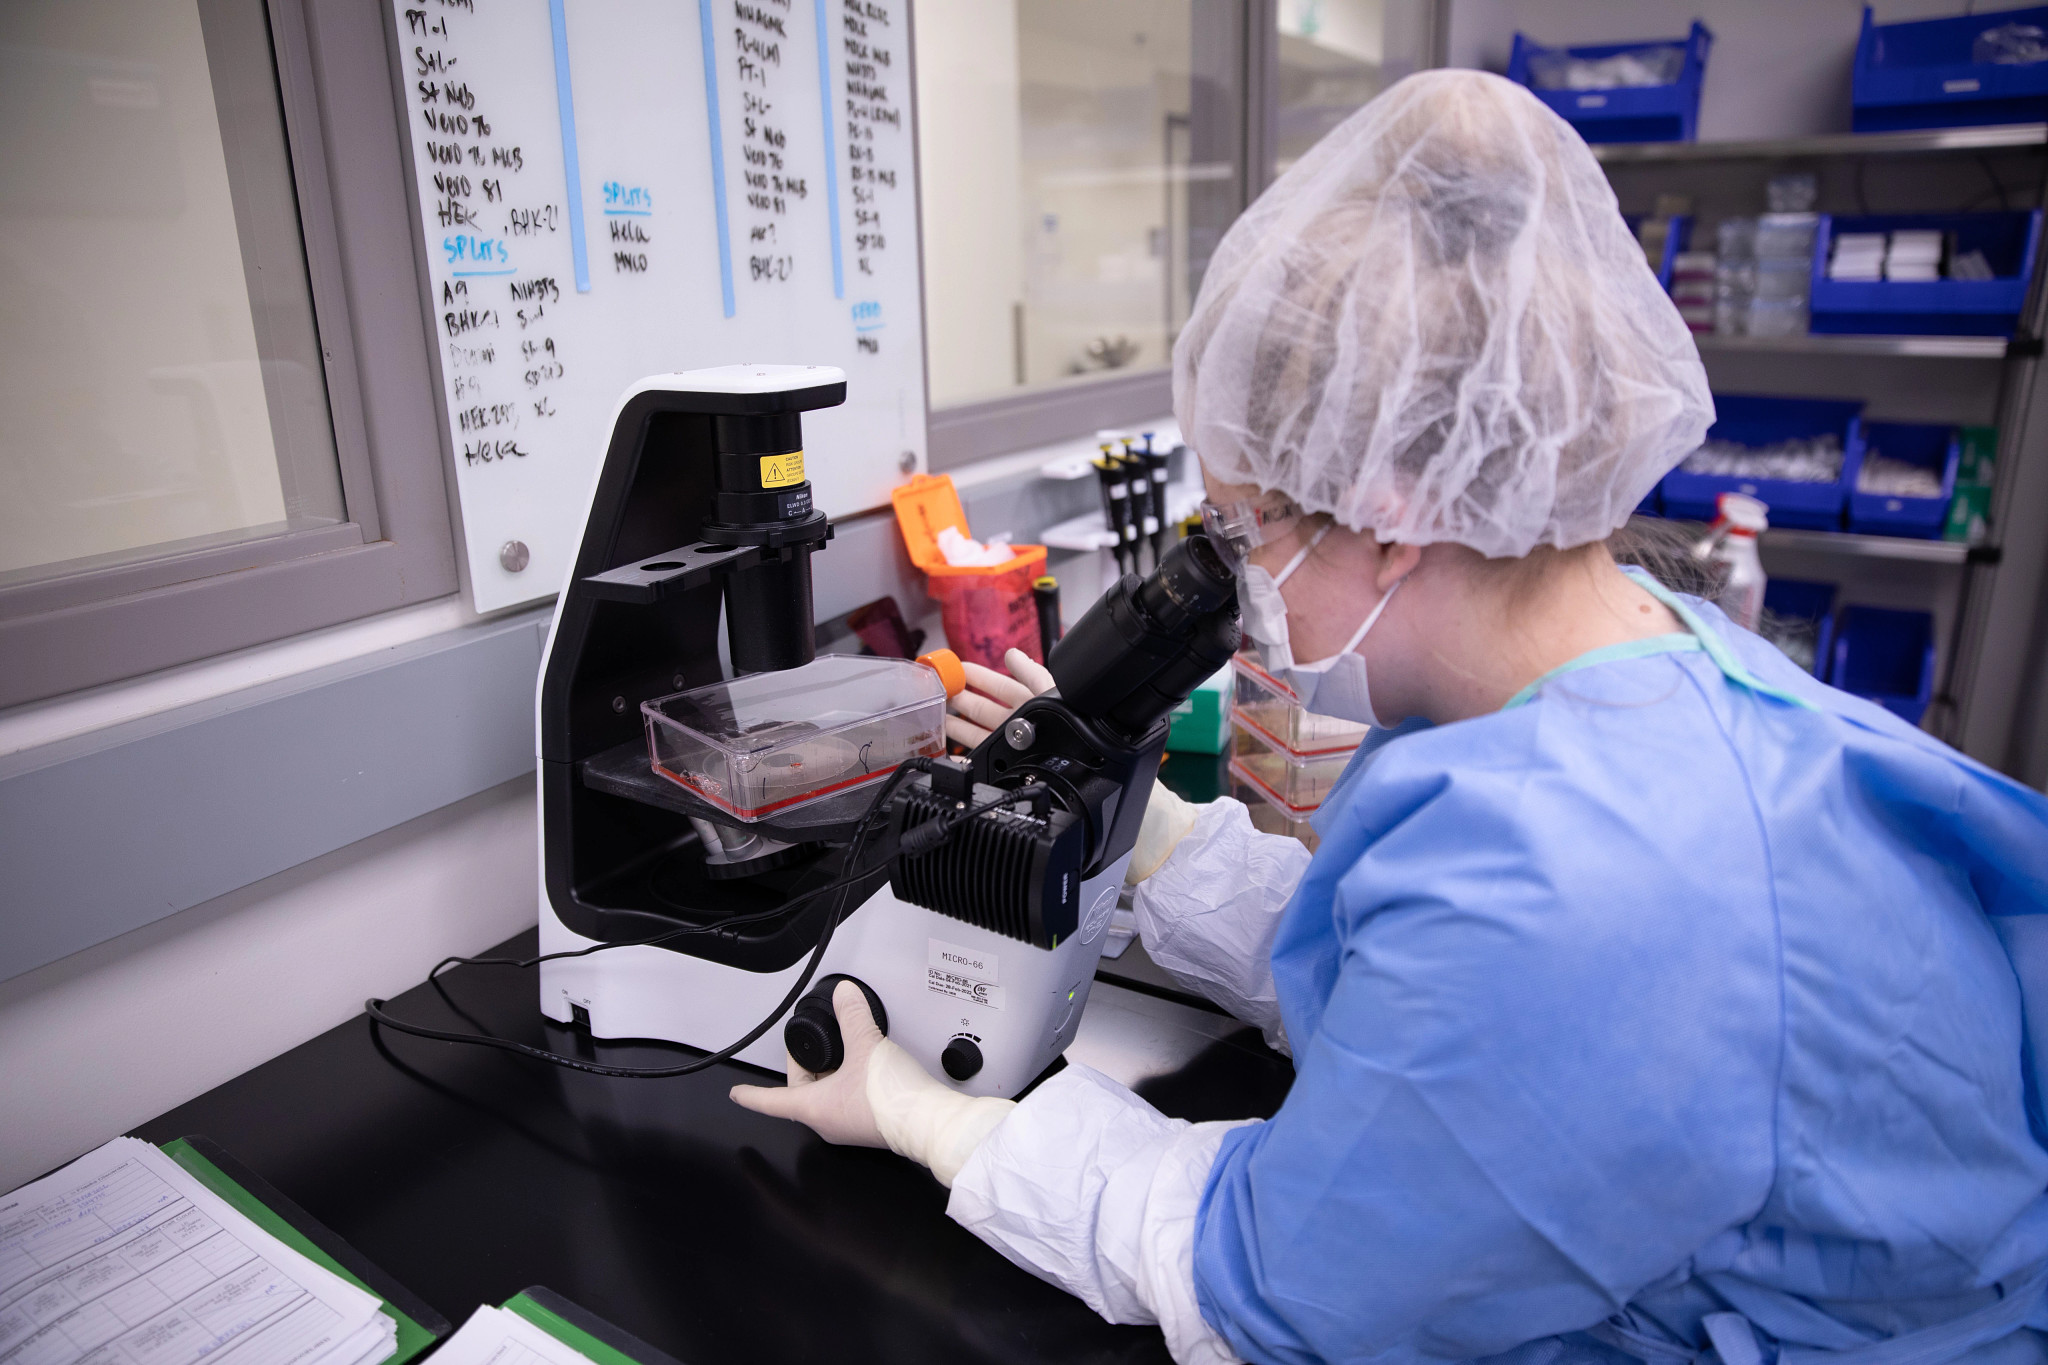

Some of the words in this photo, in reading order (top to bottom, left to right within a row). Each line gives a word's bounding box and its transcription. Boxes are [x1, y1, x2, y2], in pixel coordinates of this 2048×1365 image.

[603, 181, 652, 208] SPLITS
[443, 234, 508, 264] SPLITS
[942, 952, 983, 969] MICRO-66
